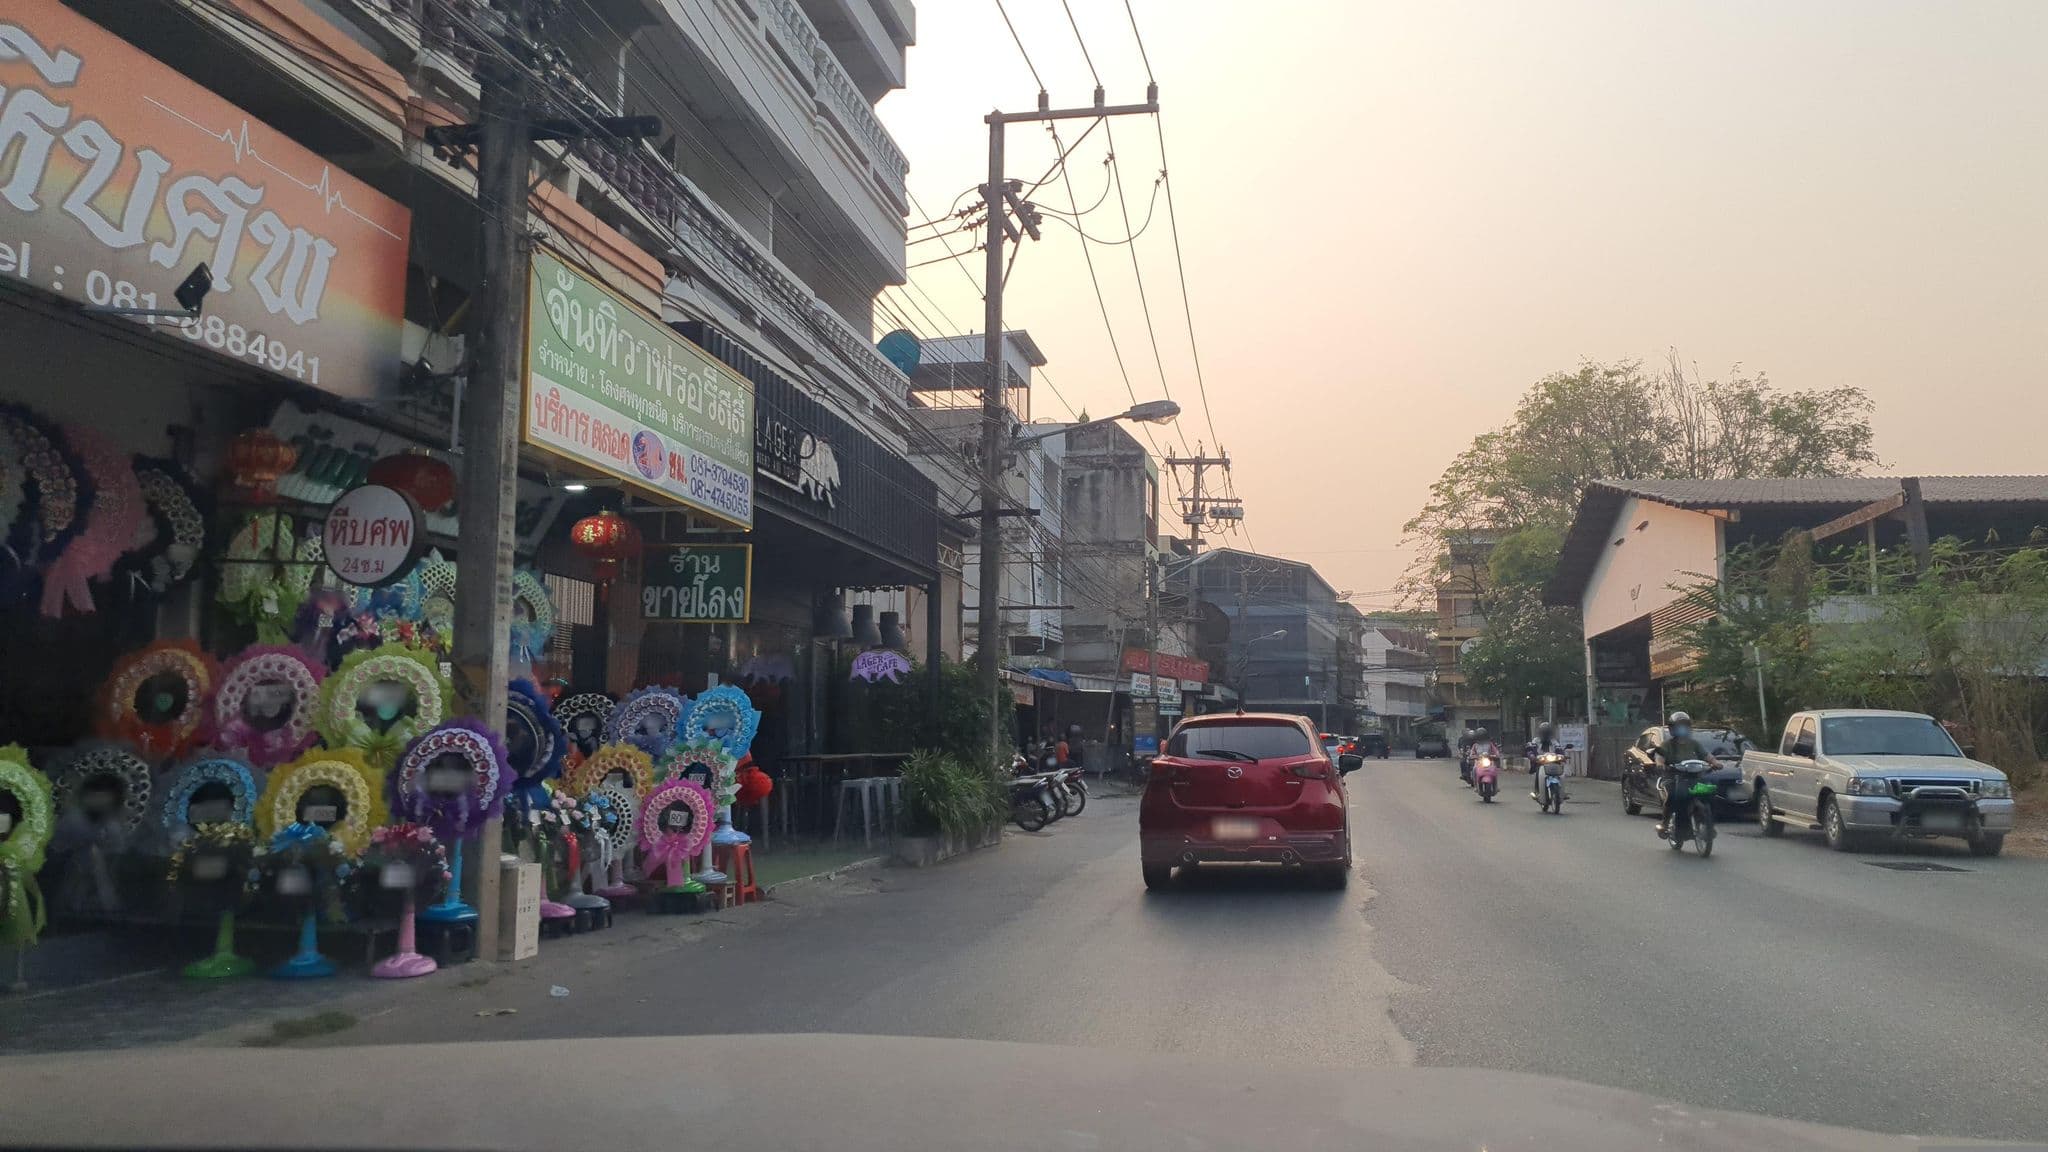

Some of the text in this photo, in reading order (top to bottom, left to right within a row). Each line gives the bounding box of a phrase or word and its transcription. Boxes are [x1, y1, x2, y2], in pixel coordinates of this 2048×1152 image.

[538, 338, 588, 386] จำหน่าย
[535, 386, 590, 446] บริการ
[592, 418, 631, 465] ตลอด
[690, 477, 749, 517] 081-4745055
[330, 508, 410, 547] หีบศพ
[669, 547, 720, 573] ร้าน
[643, 573, 745, 618] ขายโลง
